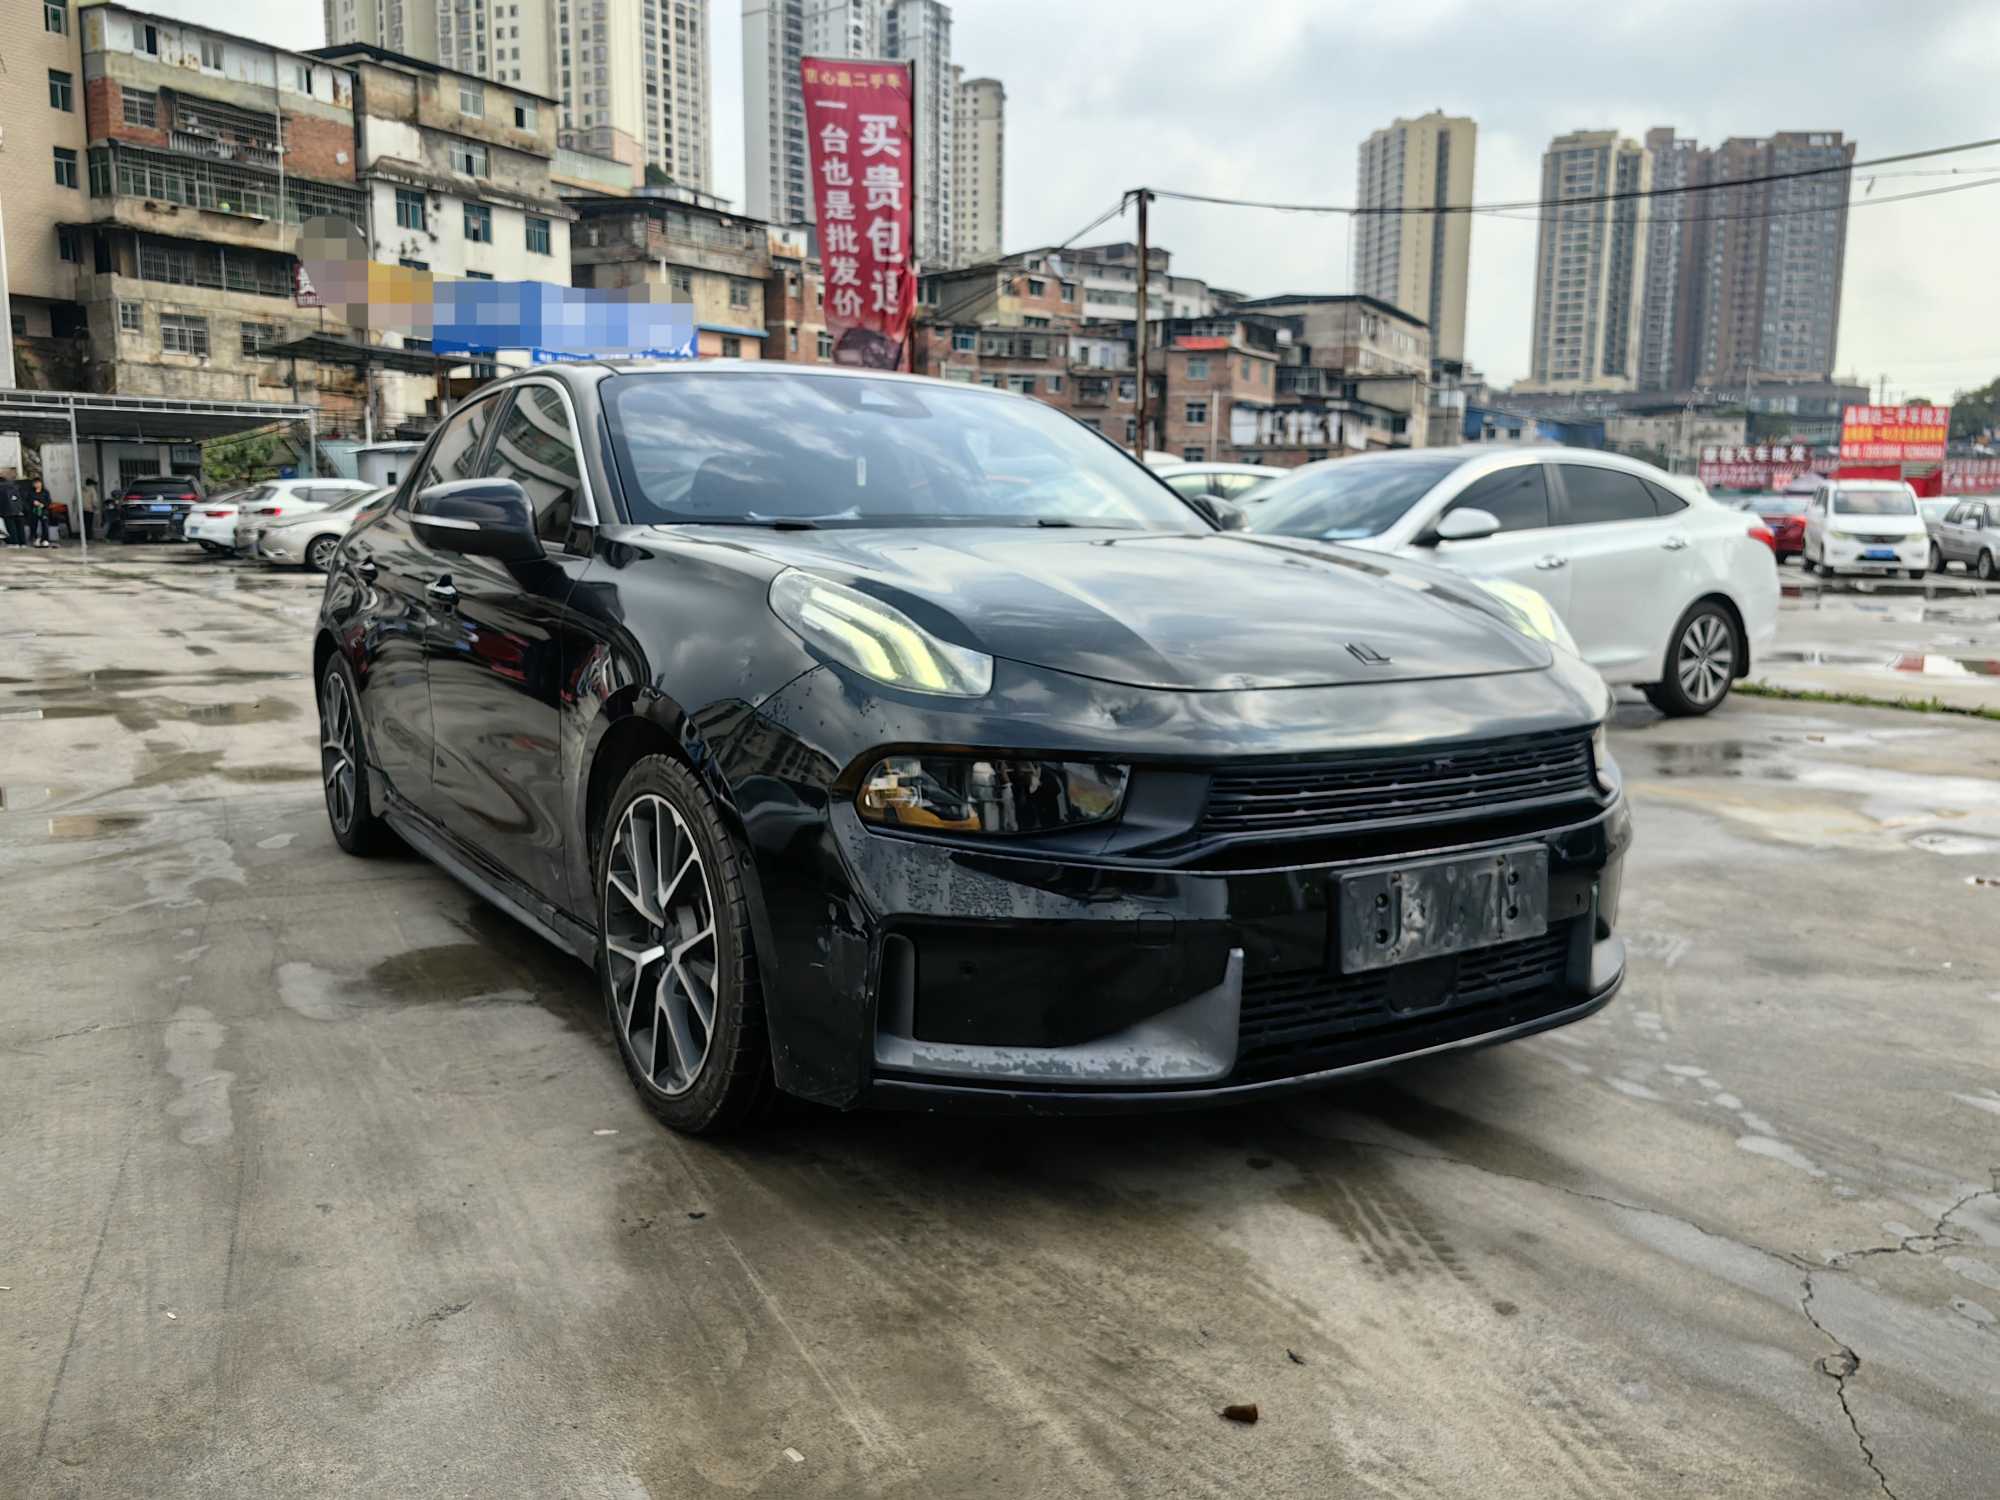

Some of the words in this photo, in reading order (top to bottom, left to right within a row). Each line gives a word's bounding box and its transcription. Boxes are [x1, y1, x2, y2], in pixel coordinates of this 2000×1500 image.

[804, 68, 901, 89] 心二手车
[815, 99, 864, 319] 一台也是批发价
[858, 113, 904, 315] 买贵包退
